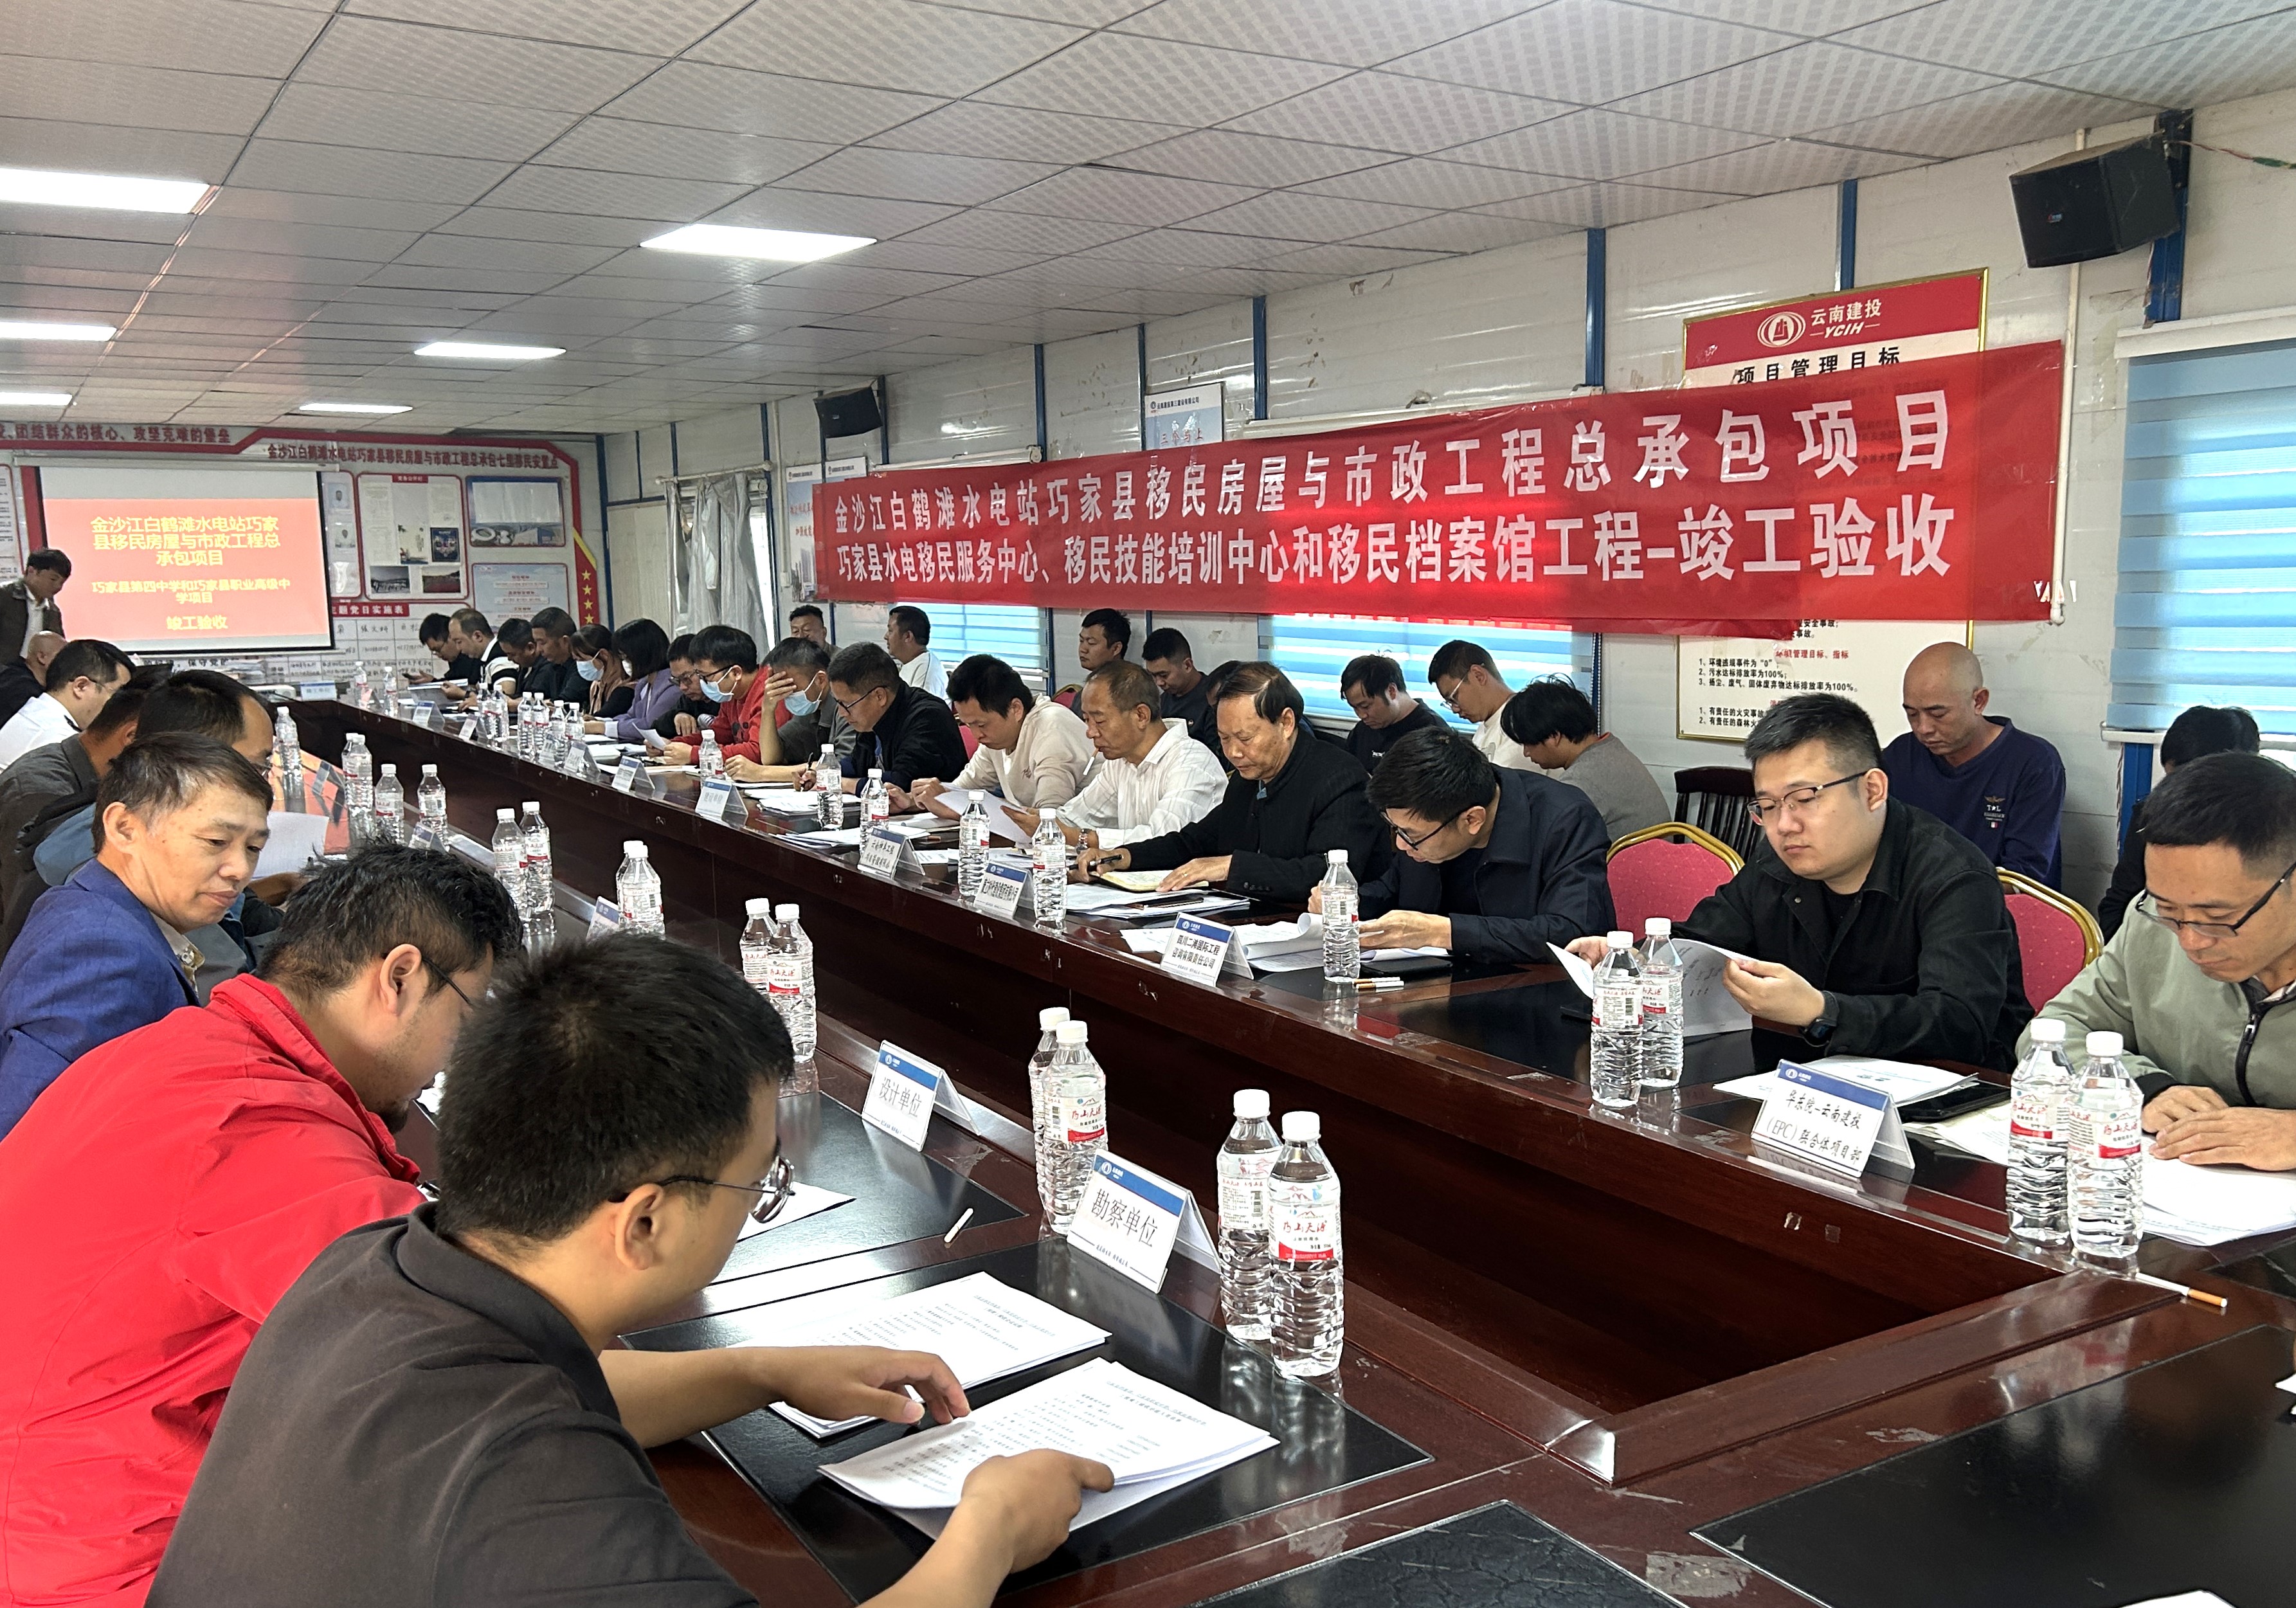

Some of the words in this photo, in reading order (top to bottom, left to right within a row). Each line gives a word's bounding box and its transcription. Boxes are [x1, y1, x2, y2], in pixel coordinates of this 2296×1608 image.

[1811, 299, 1882, 326] 云南建投
[1825, 321, 1865, 338] YCIH
[1735, 347, 1900, 384] 项目管理目标
[835, 390, 1948, 534] 金沙江白鹤滩水电站巧家县移民房屋与市政工程总承包项目
[90, 516, 279, 533] 金沙江白鹤滩水电站巧家
[93, 533, 281, 550] 县移民房屋与市政工程总
[156, 550, 223, 566] 承包项目
[91, 578, 291, 593] 巧家县第四中学和巧家县职业高级中
[176, 591, 213, 604] 学项目
[166, 615, 228, 630] 竣工验收
[878, 1077, 922, 1117] 设计单位
[1091, 1188, 1158, 1247] 勘察单位
